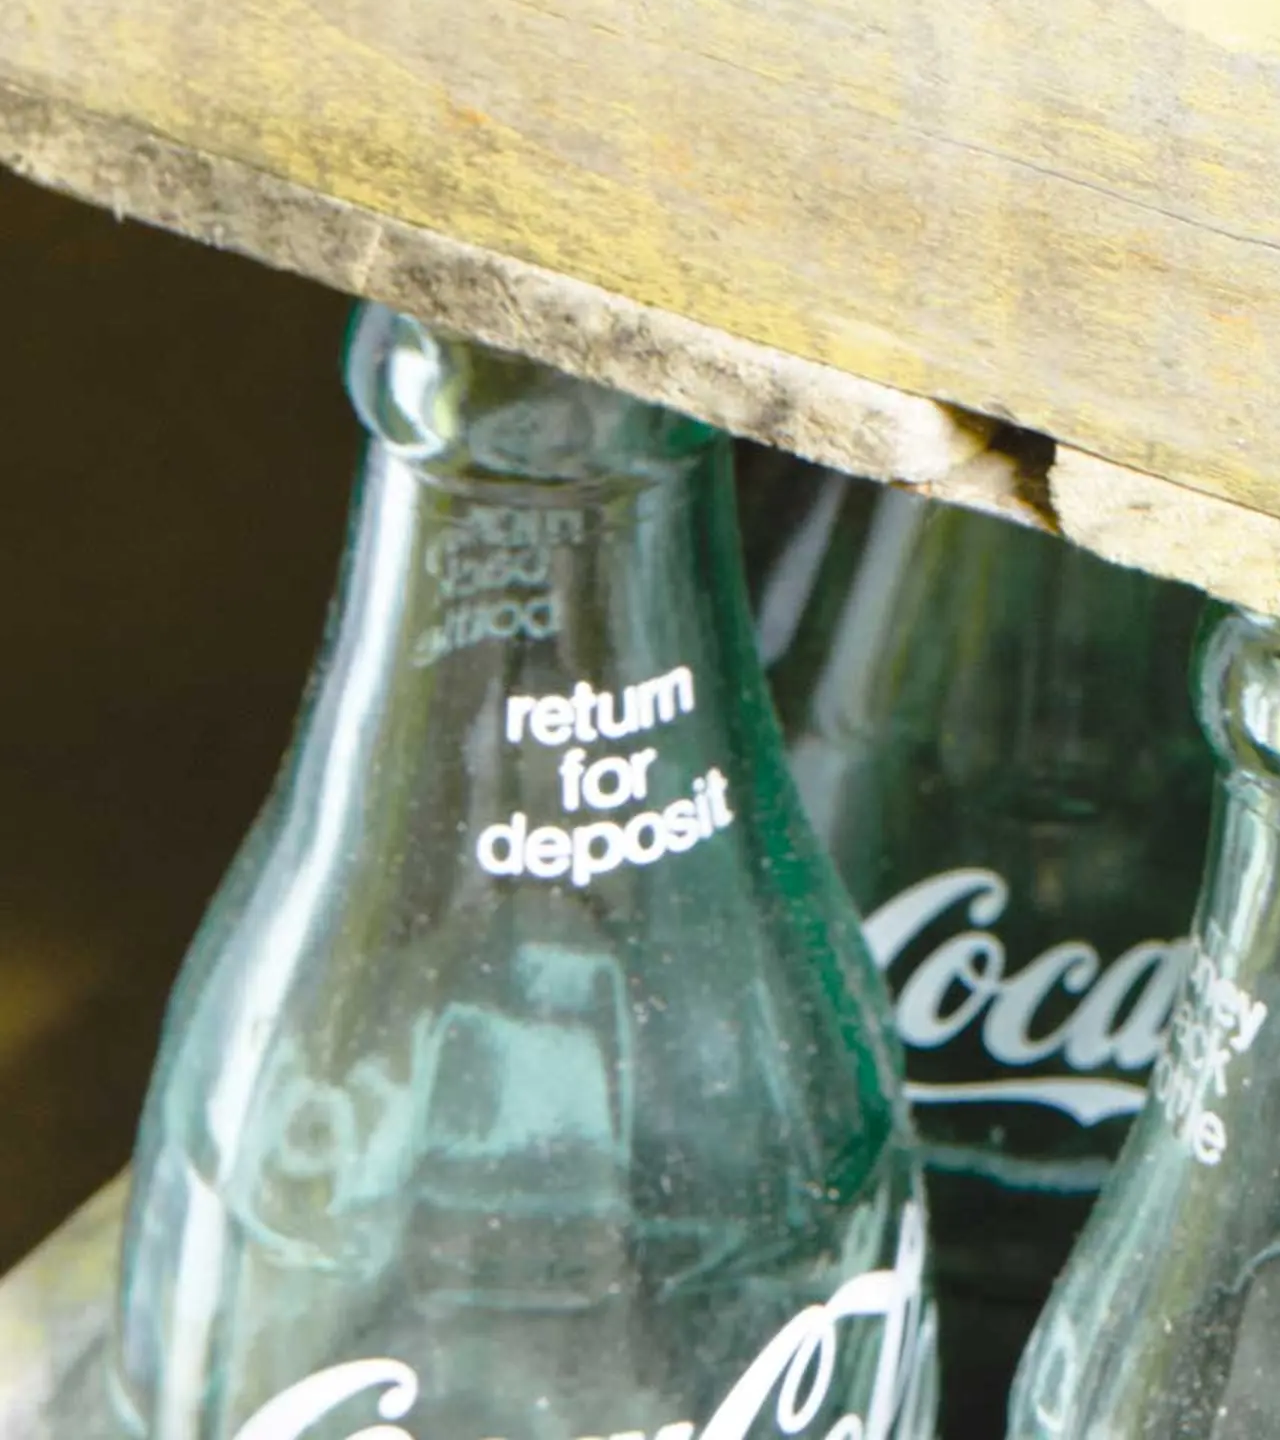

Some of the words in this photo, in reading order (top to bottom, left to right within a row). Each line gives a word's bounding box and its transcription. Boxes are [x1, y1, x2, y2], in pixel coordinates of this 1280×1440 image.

[506, 665, 695, 747] return
[559, 747, 658, 812] for
[475, 767, 735, 887] deposit
